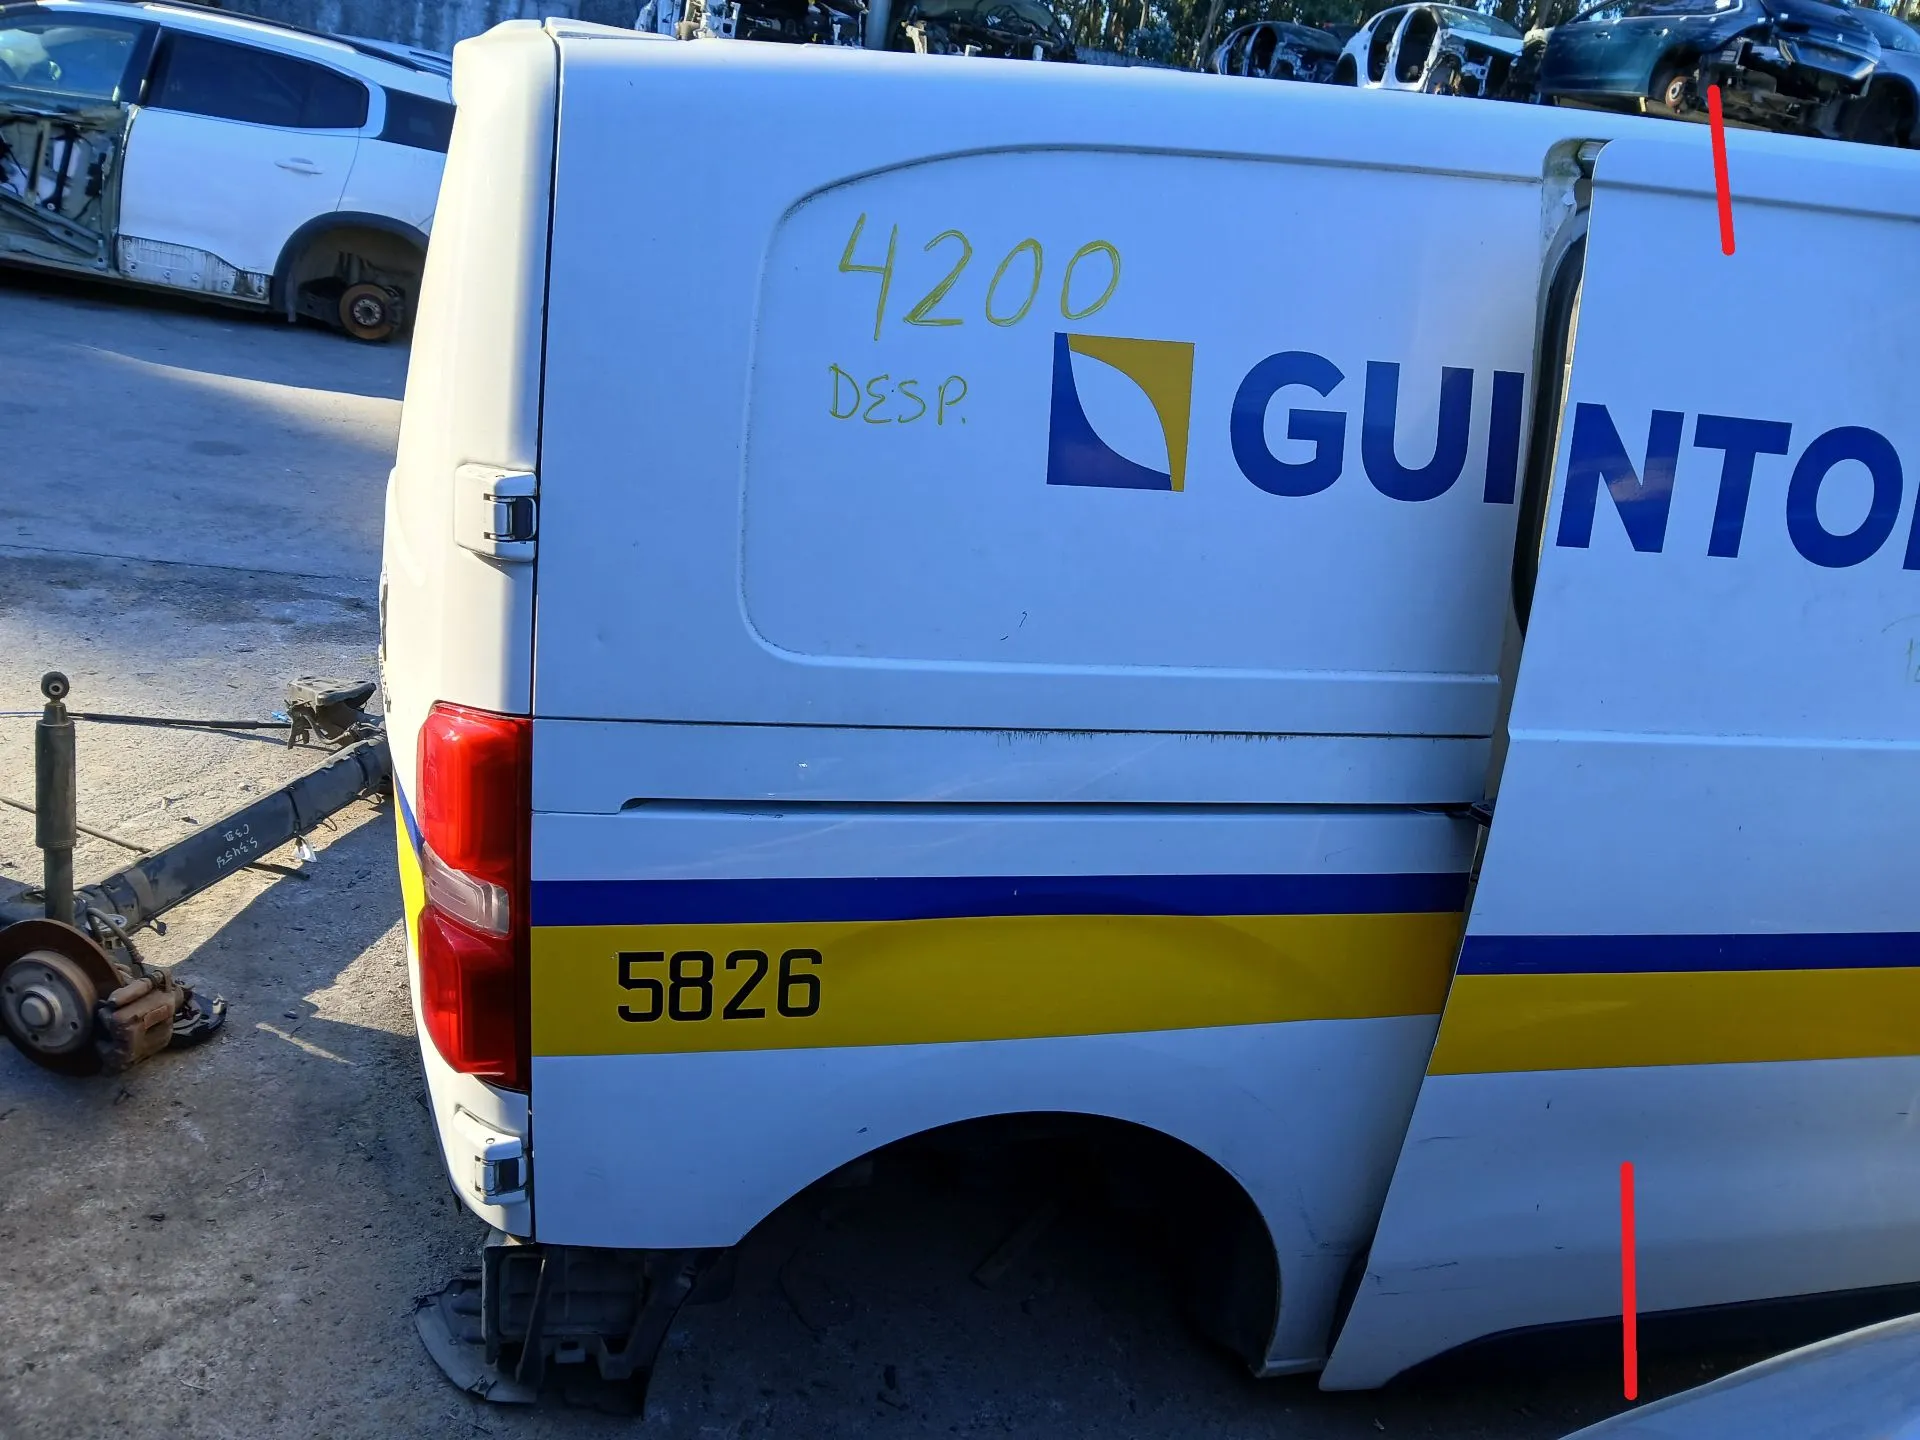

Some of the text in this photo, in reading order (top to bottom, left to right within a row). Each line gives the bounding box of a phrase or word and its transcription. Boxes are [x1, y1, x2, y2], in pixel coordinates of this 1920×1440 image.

[838, 212, 1122, 342] 4200
[829, 363, 968, 426] DESP.
[617, 948, 823, 1023] 5826
